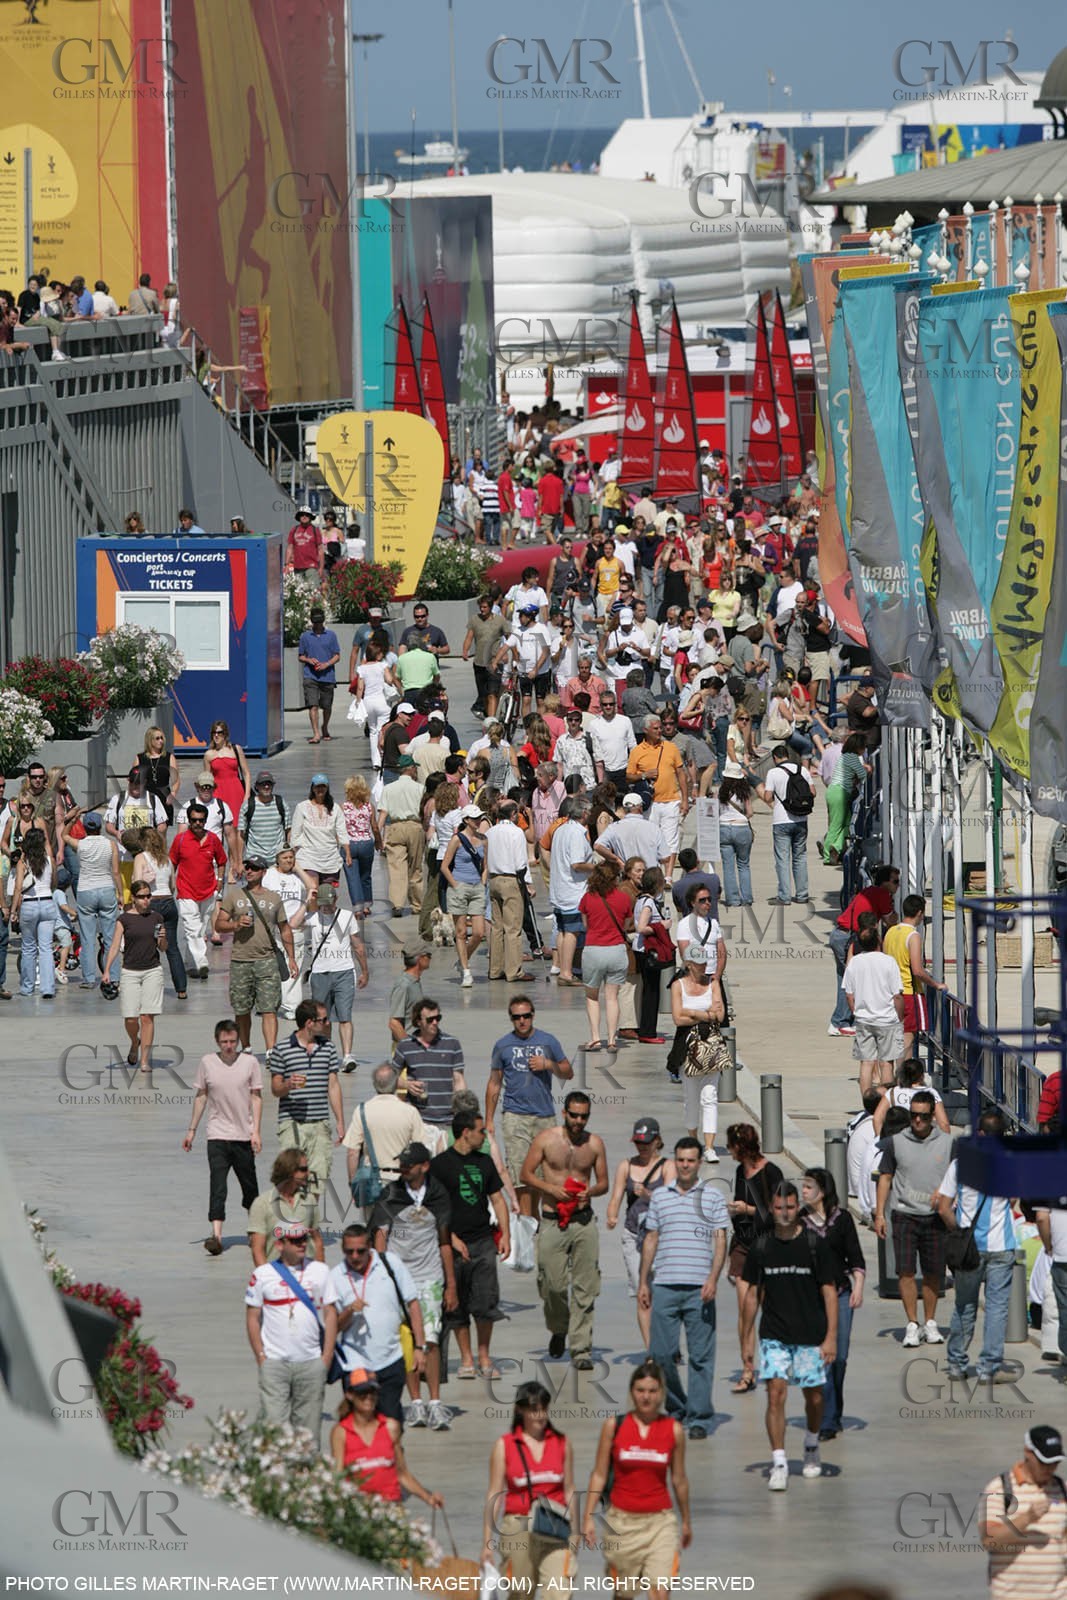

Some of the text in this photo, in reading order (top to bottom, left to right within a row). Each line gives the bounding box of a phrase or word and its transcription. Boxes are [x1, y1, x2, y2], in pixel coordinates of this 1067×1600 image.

[117, 552, 173, 563] Conciertos
[181, 552, 226, 562] Concerts
[146, 564, 163, 573] port
[149, 580, 193, 590] TICKETS
